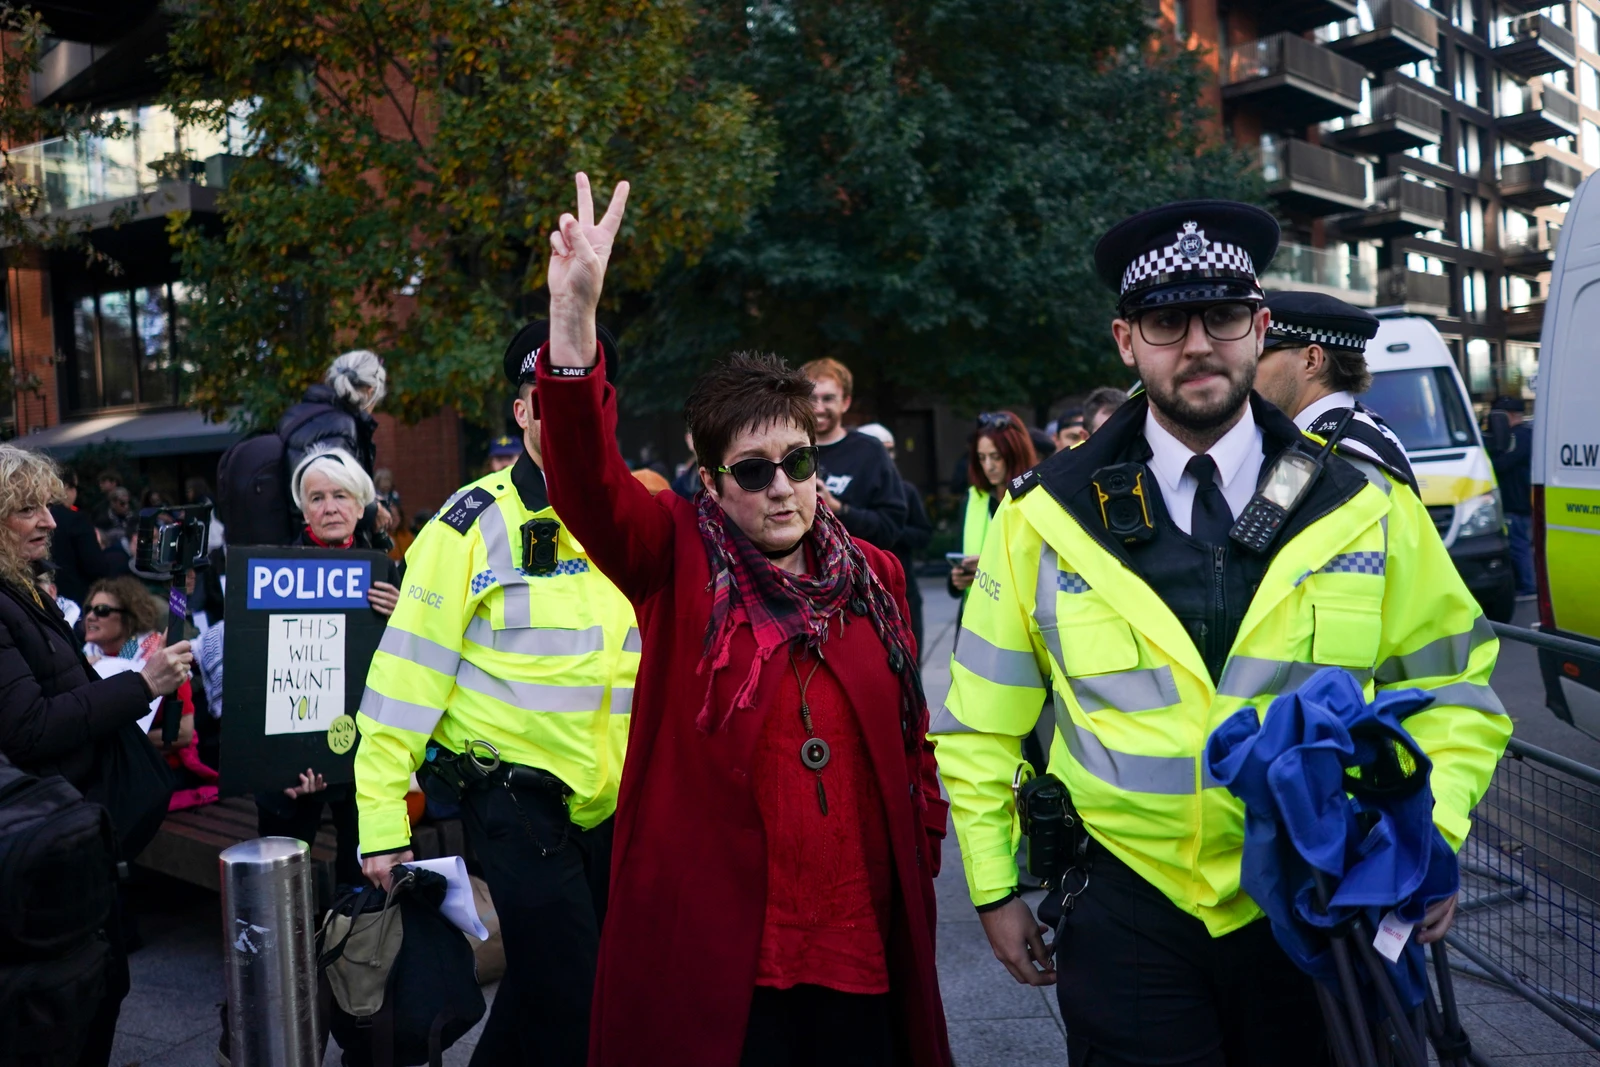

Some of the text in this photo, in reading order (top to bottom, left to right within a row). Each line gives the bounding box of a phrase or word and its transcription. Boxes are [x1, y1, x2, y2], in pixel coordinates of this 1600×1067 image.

[562, 368, 585, 376] SAVE
[1560, 443, 1599, 467] QLW
[253, 566, 363, 599] POLICE
[407, 584, 444, 609] POLICE
[282, 618, 338, 640] THIS
[289, 644, 330, 663] WILL
[271, 667, 341, 693] HAUNT
[289, 695, 319, 726] YOU
[330, 722, 354, 733] JOIN
[333, 734, 350, 748] US
